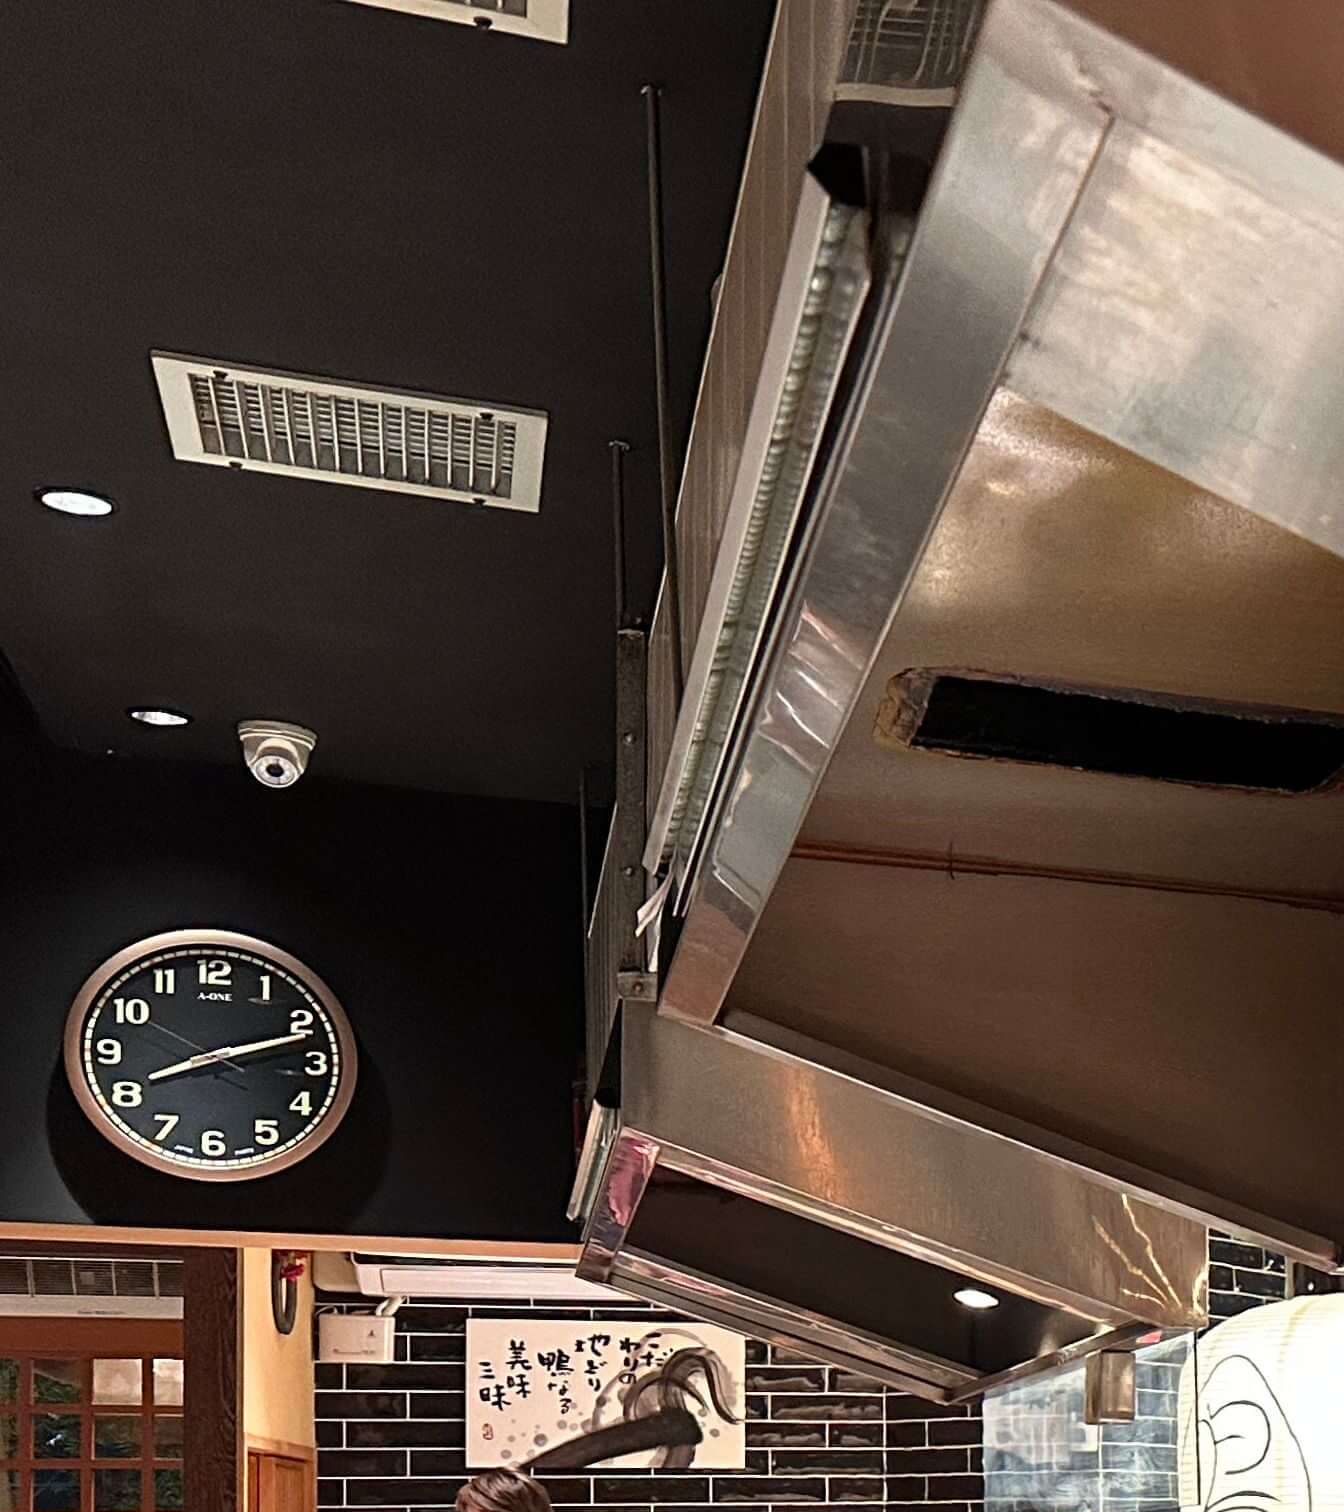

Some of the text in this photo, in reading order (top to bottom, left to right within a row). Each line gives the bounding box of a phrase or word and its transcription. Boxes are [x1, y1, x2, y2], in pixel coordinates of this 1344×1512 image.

[154, 969, 175, 994] 11
[197, 960, 232, 986] 12
[197, 992, 232, 1002] A-ONE
[260, 976, 271, 1000] 1
[114, 998, 149, 1024] 10
[290, 1009, 313, 1035] 2
[97, 1039, 122, 1064] 9
[305, 1051, 327, 1075] 3
[112, 1081, 142, 1107] 8
[289, 1091, 312, 1116] 4
[154, 1114, 179, 1140] 7
[255, 1120, 278, 1145] 5
[201, 1130, 226, 1156] 6
